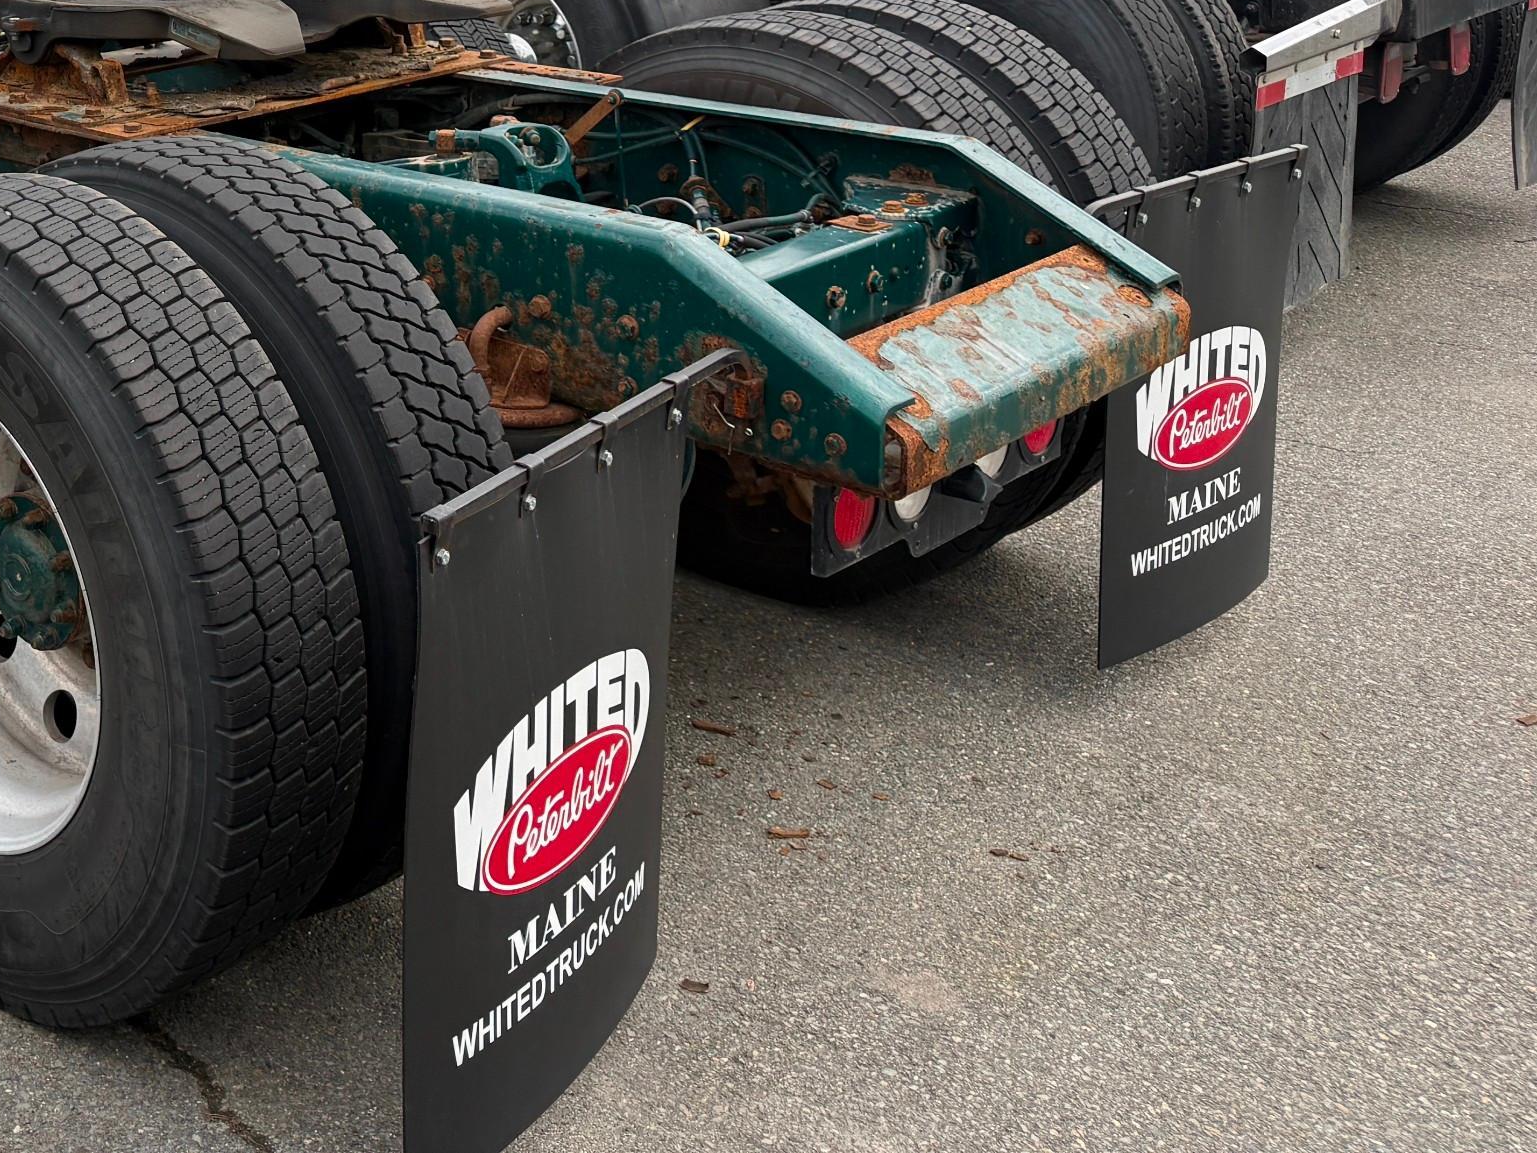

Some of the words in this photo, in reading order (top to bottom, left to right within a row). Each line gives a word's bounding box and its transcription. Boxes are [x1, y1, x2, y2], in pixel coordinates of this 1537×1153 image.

[1135, 325, 1267, 461] WHITED
[1168, 391, 1249, 458] Peterbilt
[1130, 493, 1261, 578] WHITEDTRUCK.COM
[1166, 467, 1242, 526] MAINE
[453, 647, 651, 893] WHITED
[506, 738, 626, 879] Peterbilt
[452, 861, 646, 1067] WHITEDTRUCK.COM
[507, 845, 619, 975] MAINE
